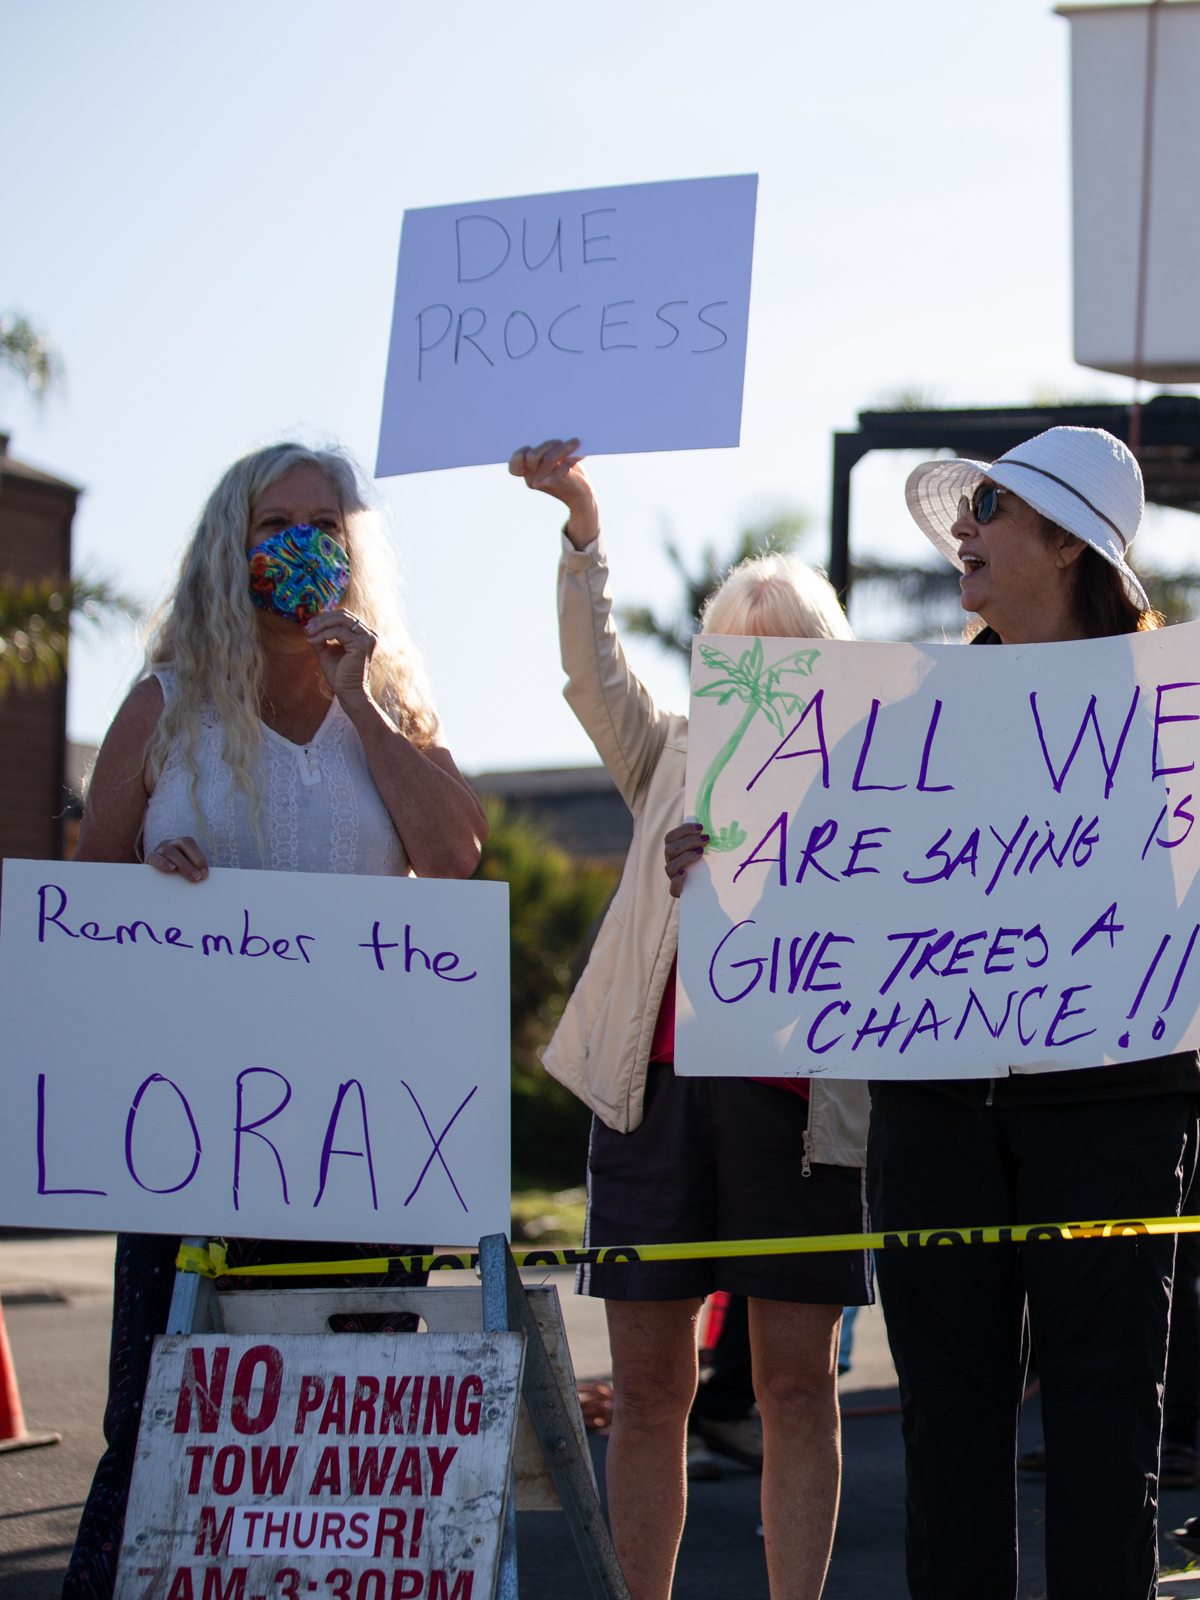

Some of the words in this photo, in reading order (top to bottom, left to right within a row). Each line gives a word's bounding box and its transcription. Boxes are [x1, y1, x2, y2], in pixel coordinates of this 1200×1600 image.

[455, 207, 617, 283] DUE
[415, 299, 728, 382] PROCESS
[746, 689, 955, 792] ALL
[733, 811, 892, 887] ARE
[38, 884, 316, 964] Remember
[359, 920, 477, 983] the
[708, 920, 855, 1003] GIVE
[879, 924, 1048, 996] TREES
[1071, 902, 1125, 957] A
[37, 1067, 478, 1213] LORAX
[173, 1344, 284, 1436] NO
[293, 1374, 484, 1437] PARKING
[186, 1444, 300, 1497] TOW
[308, 1445, 459, 1497] AWAY
